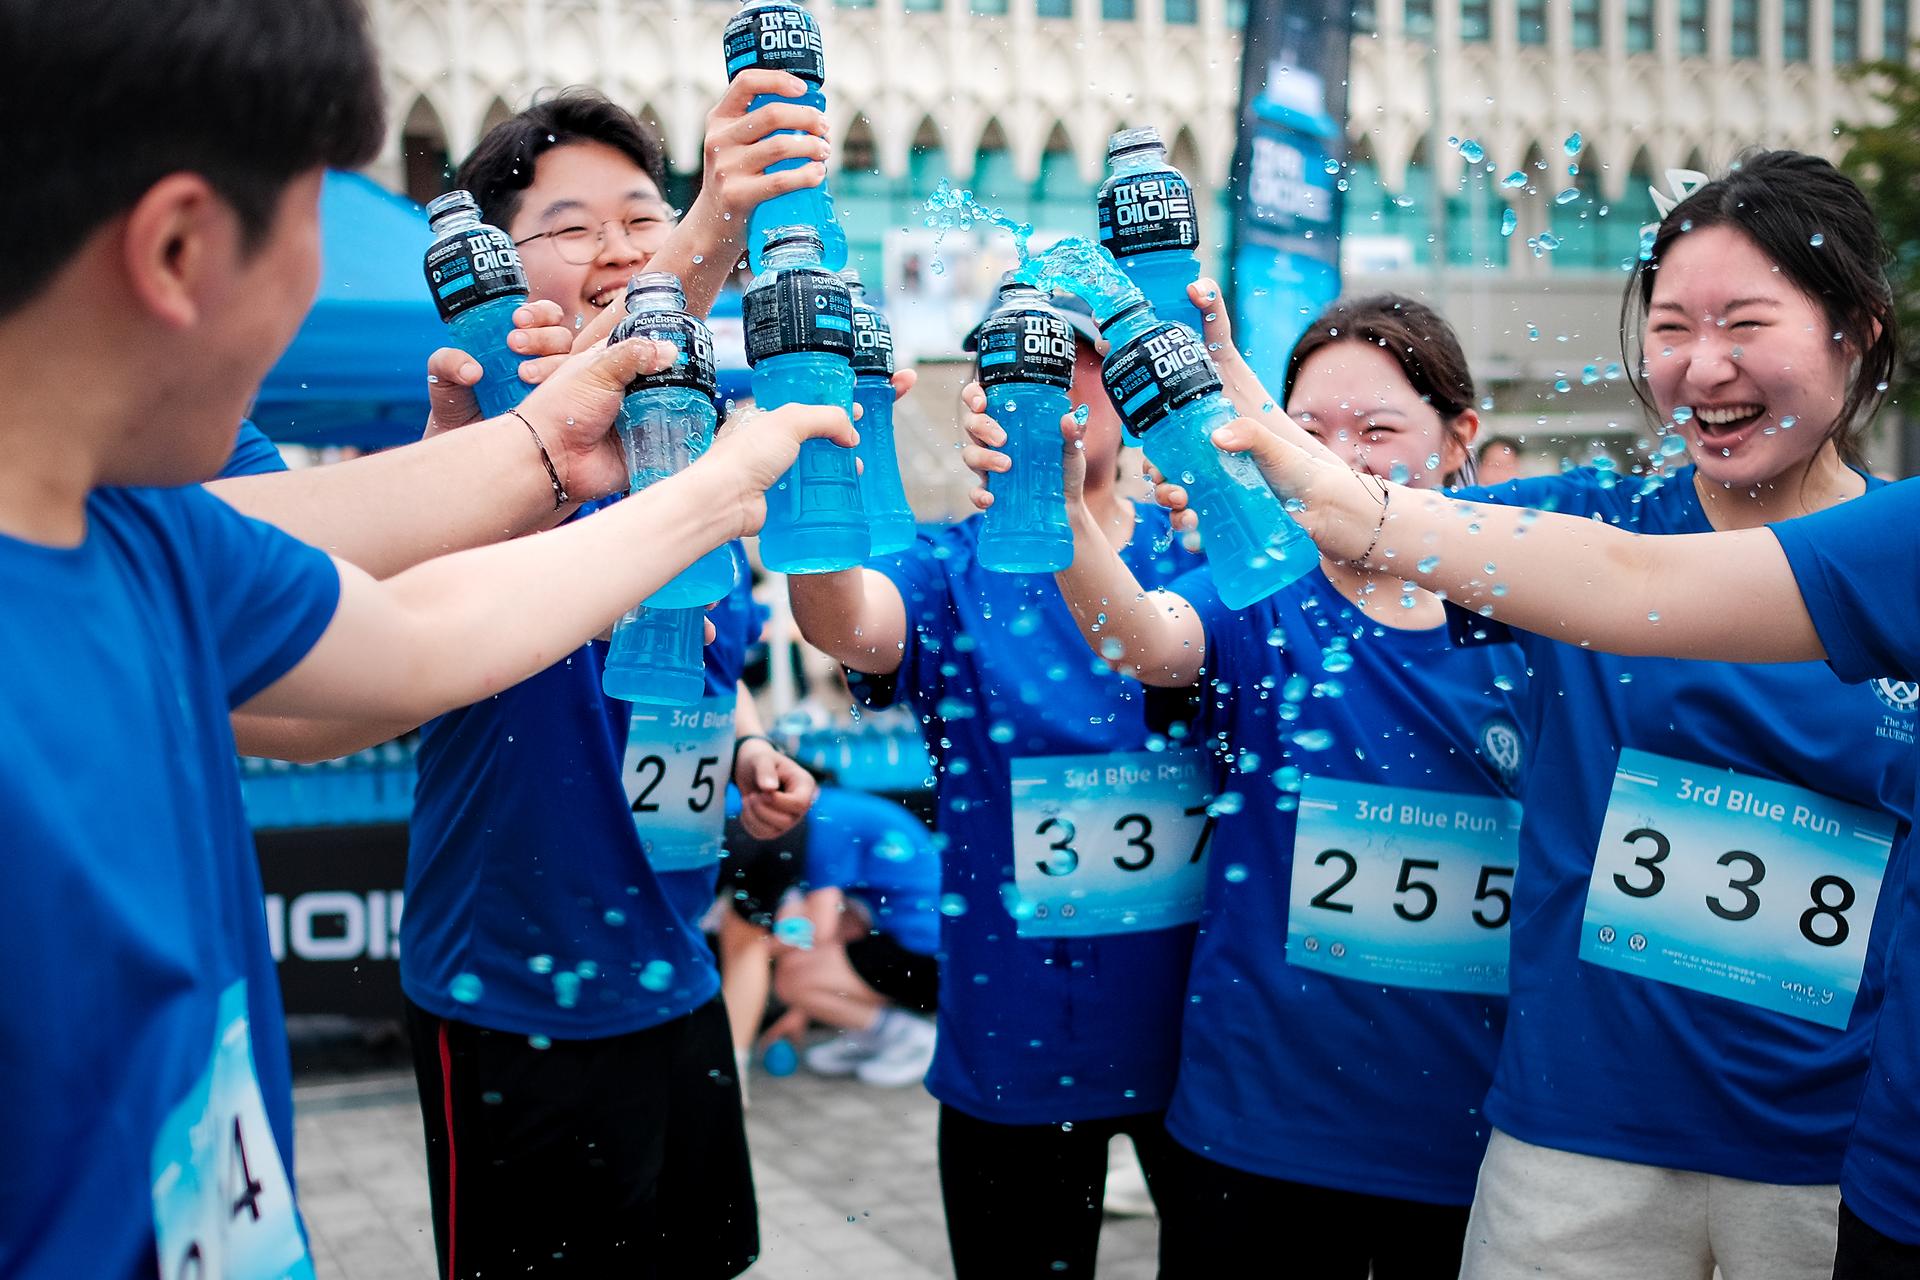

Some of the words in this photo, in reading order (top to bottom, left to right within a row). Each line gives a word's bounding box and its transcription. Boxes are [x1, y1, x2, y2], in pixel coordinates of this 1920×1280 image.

[760, 12, 807, 32] 파워
[760, 30, 822, 52] 에이드
[1114, 180, 1167, 206] 파워
[1116, 198, 1191, 226] 에이드
[467, 233, 511, 254] 파워
[634, 316, 684, 327] POWERADE
[854, 313, 877, 330] 워
[1024, 316, 1068, 340] 파워
[1024, 334, 1076, 362] 에이드
[1143, 326, 1194, 360] 파워
[1104, 348, 1140, 380] POWERADE
[1154, 342, 1212, 379] 에이드
[670, 710, 700, 728] 3rd
[1883, 714, 1900, 728] The
[1064, 768, 1098, 788] 3rd
[1106, 767, 1150, 786] Blue
[1158, 764, 1195, 780] Run
[1355, 800, 1394, 823] 3rd
[1400, 806, 1448, 828] Blue
[1454, 812, 1497, 832] Run
[1676, 778, 1721, 806] 3rd
[1726, 790, 1786, 822] Blue
[1792, 805, 1840, 837] Run
[1034, 804, 1218, 876] 337
[1309, 848, 1514, 929] 255
[1612, 828, 1856, 947] 338
